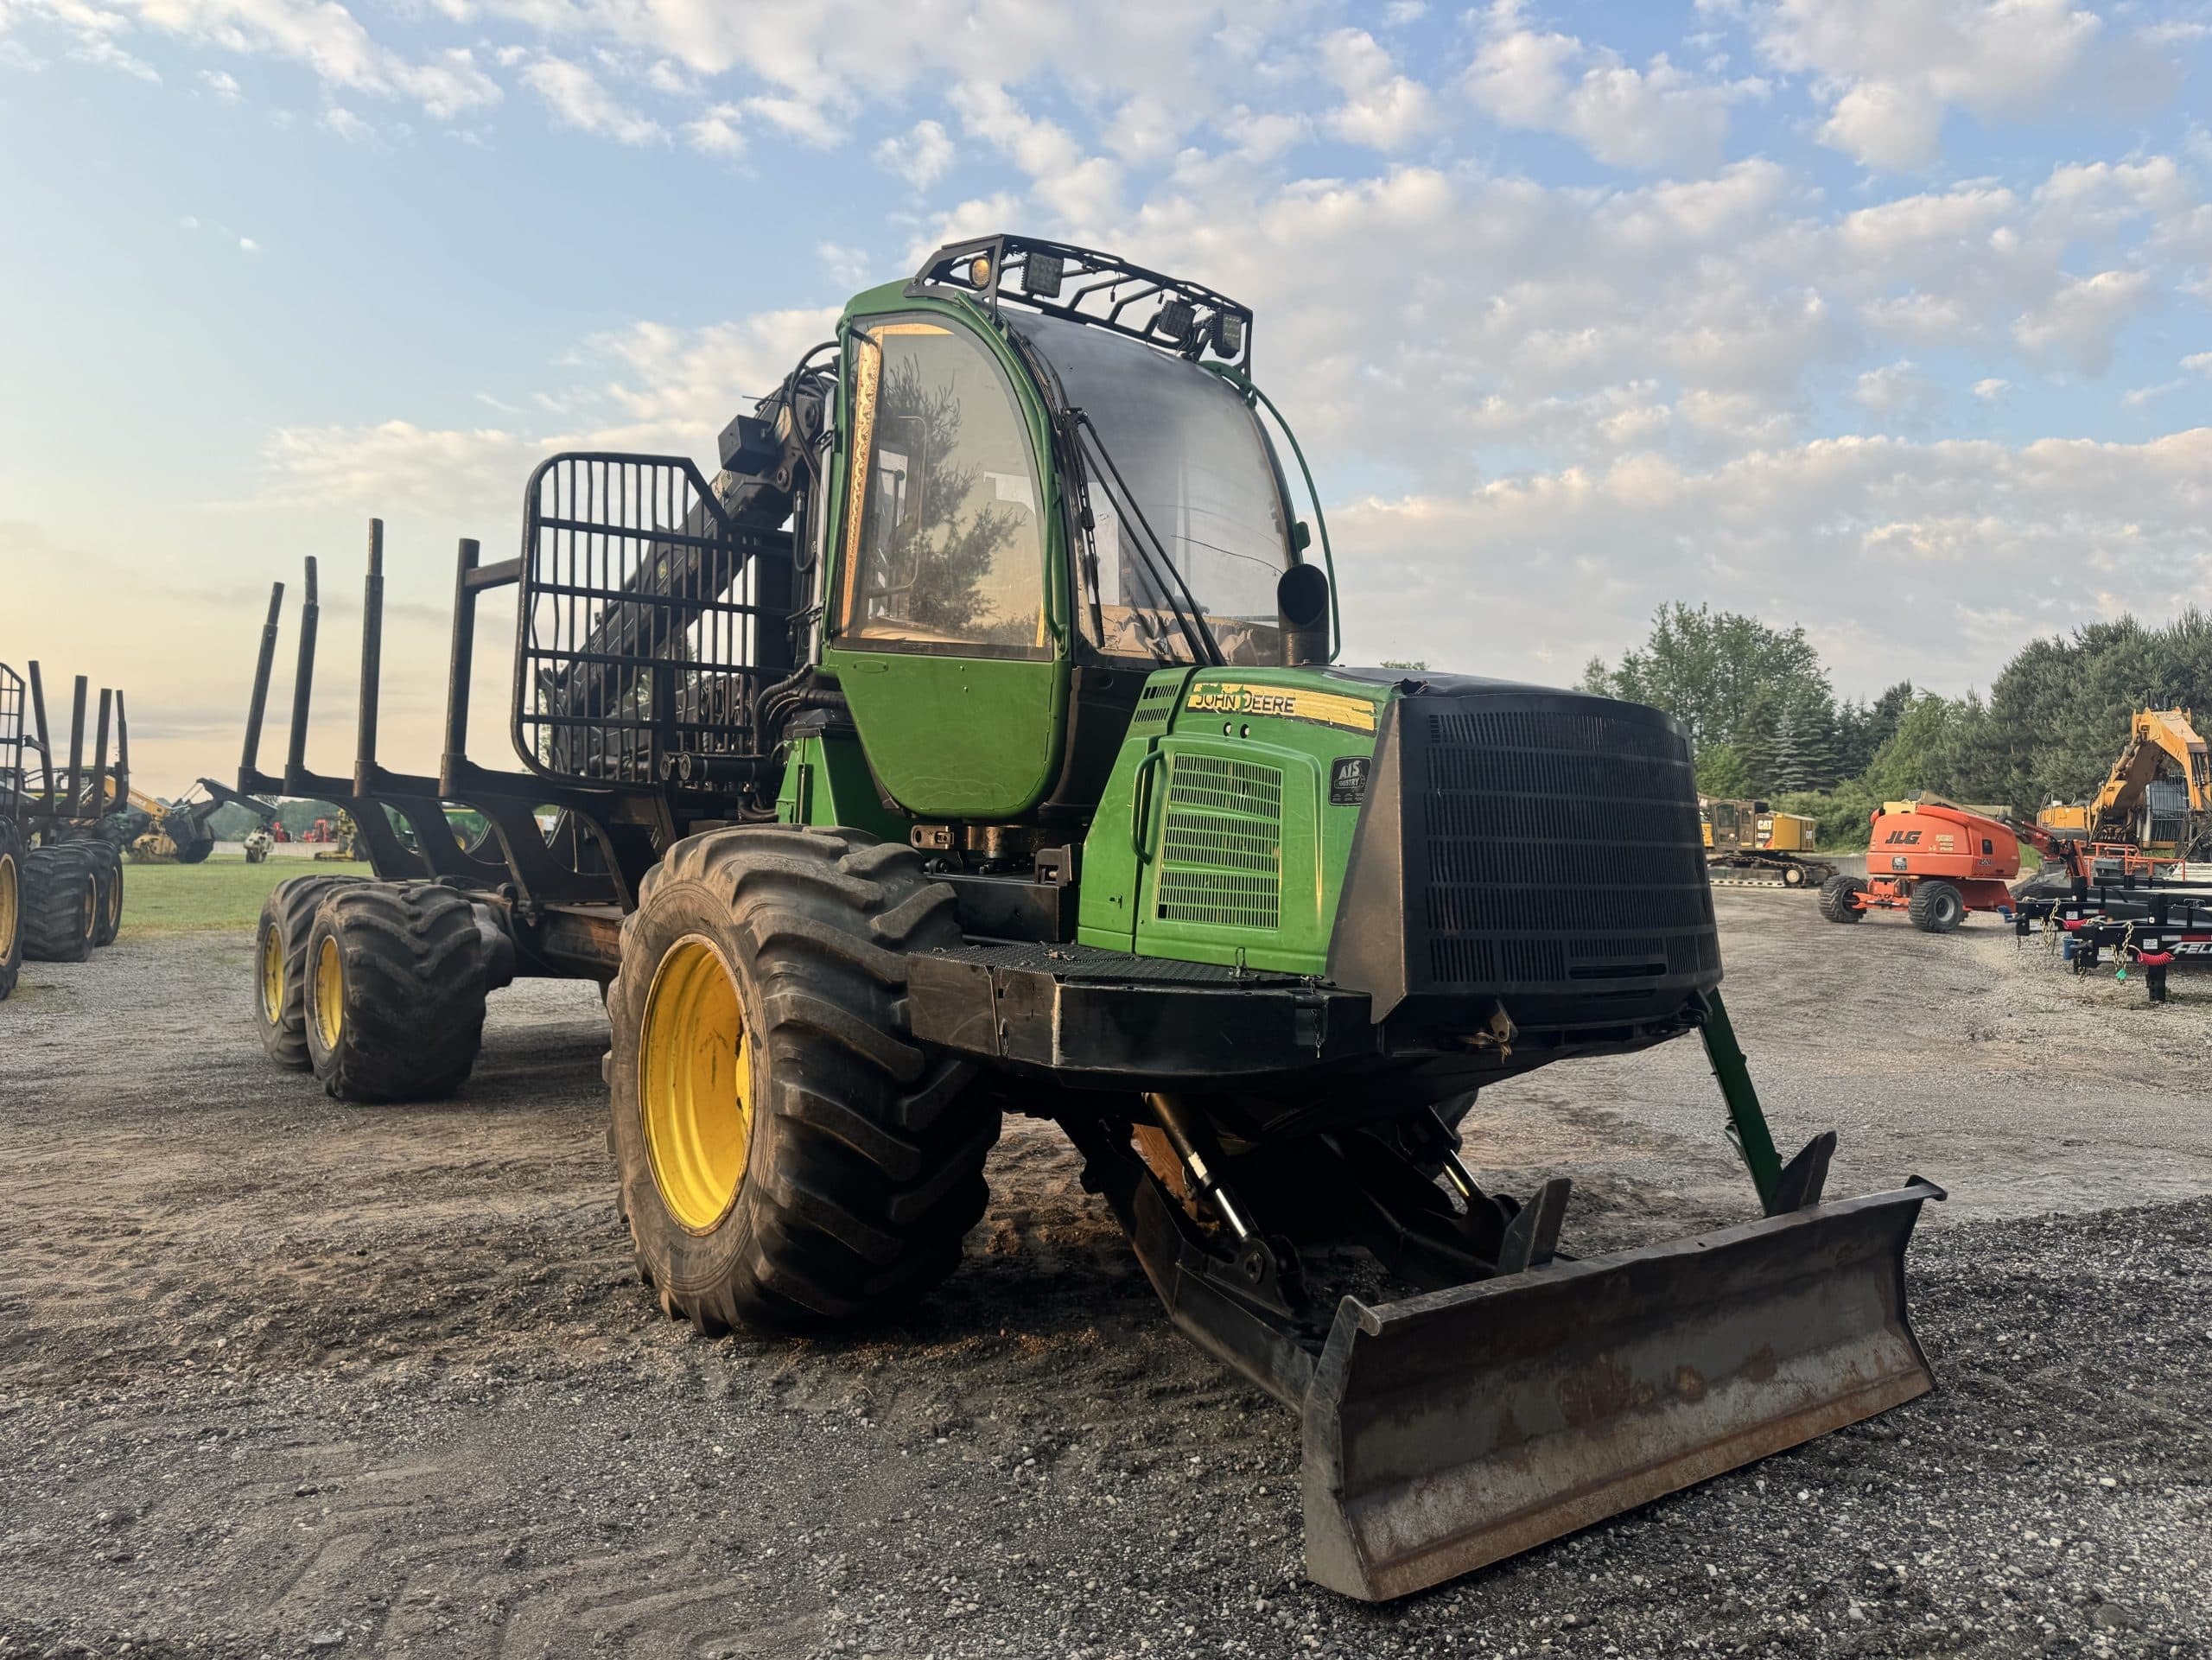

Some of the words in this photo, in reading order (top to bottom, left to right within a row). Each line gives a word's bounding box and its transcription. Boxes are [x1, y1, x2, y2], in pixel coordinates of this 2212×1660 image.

[1196, 693, 1236, 709] JOHN
[1243, 690, 1296, 713] DEERE
[1338, 760, 1362, 779] AIS
[1758, 820, 1773, 830] CAT
[1885, 830, 1923, 845] JLG
[2167, 942, 2212, 955] FEL
